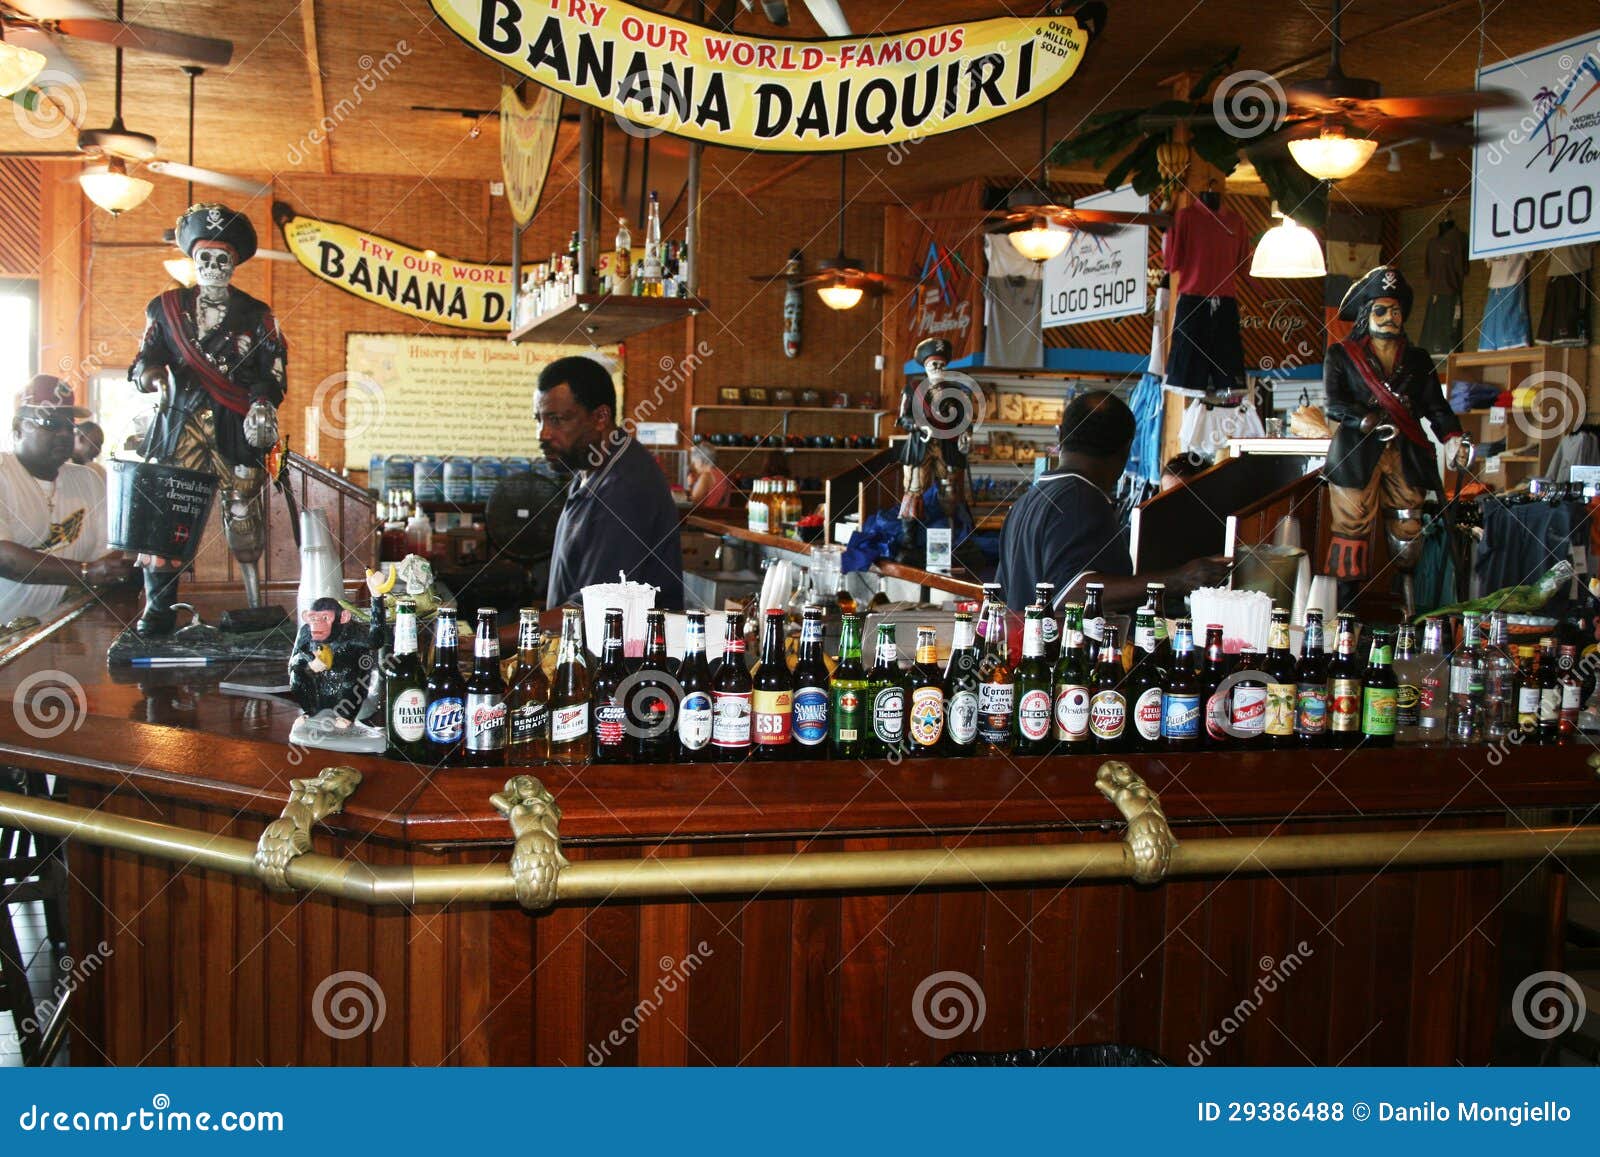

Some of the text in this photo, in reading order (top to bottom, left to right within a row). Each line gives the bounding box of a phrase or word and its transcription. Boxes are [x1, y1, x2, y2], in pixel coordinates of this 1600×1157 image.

[622, 17, 688, 57] OUR
[705, 28, 964, 70] WORLD-FAMOUS
[1035, 27, 1080, 51] 6 MILLION
[1048, 20, 1073, 37] OVER
[1040, 41, 1069, 58] SOLD!
[478, 0, 1035, 138] BANANA DAIQUIRI
[1491, 185, 1592, 238] LOGO
[360, 237, 394, 263] TRY
[403, 255, 442, 276] OUR
[318, 240, 468, 320] BANANA
[1050, 278, 1137, 316] LOGO SHOP
[756, 715, 783, 733] ESB
[794, 703, 828, 714] SAMUEL
[1093, 706, 1123, 716] AMSTEL
